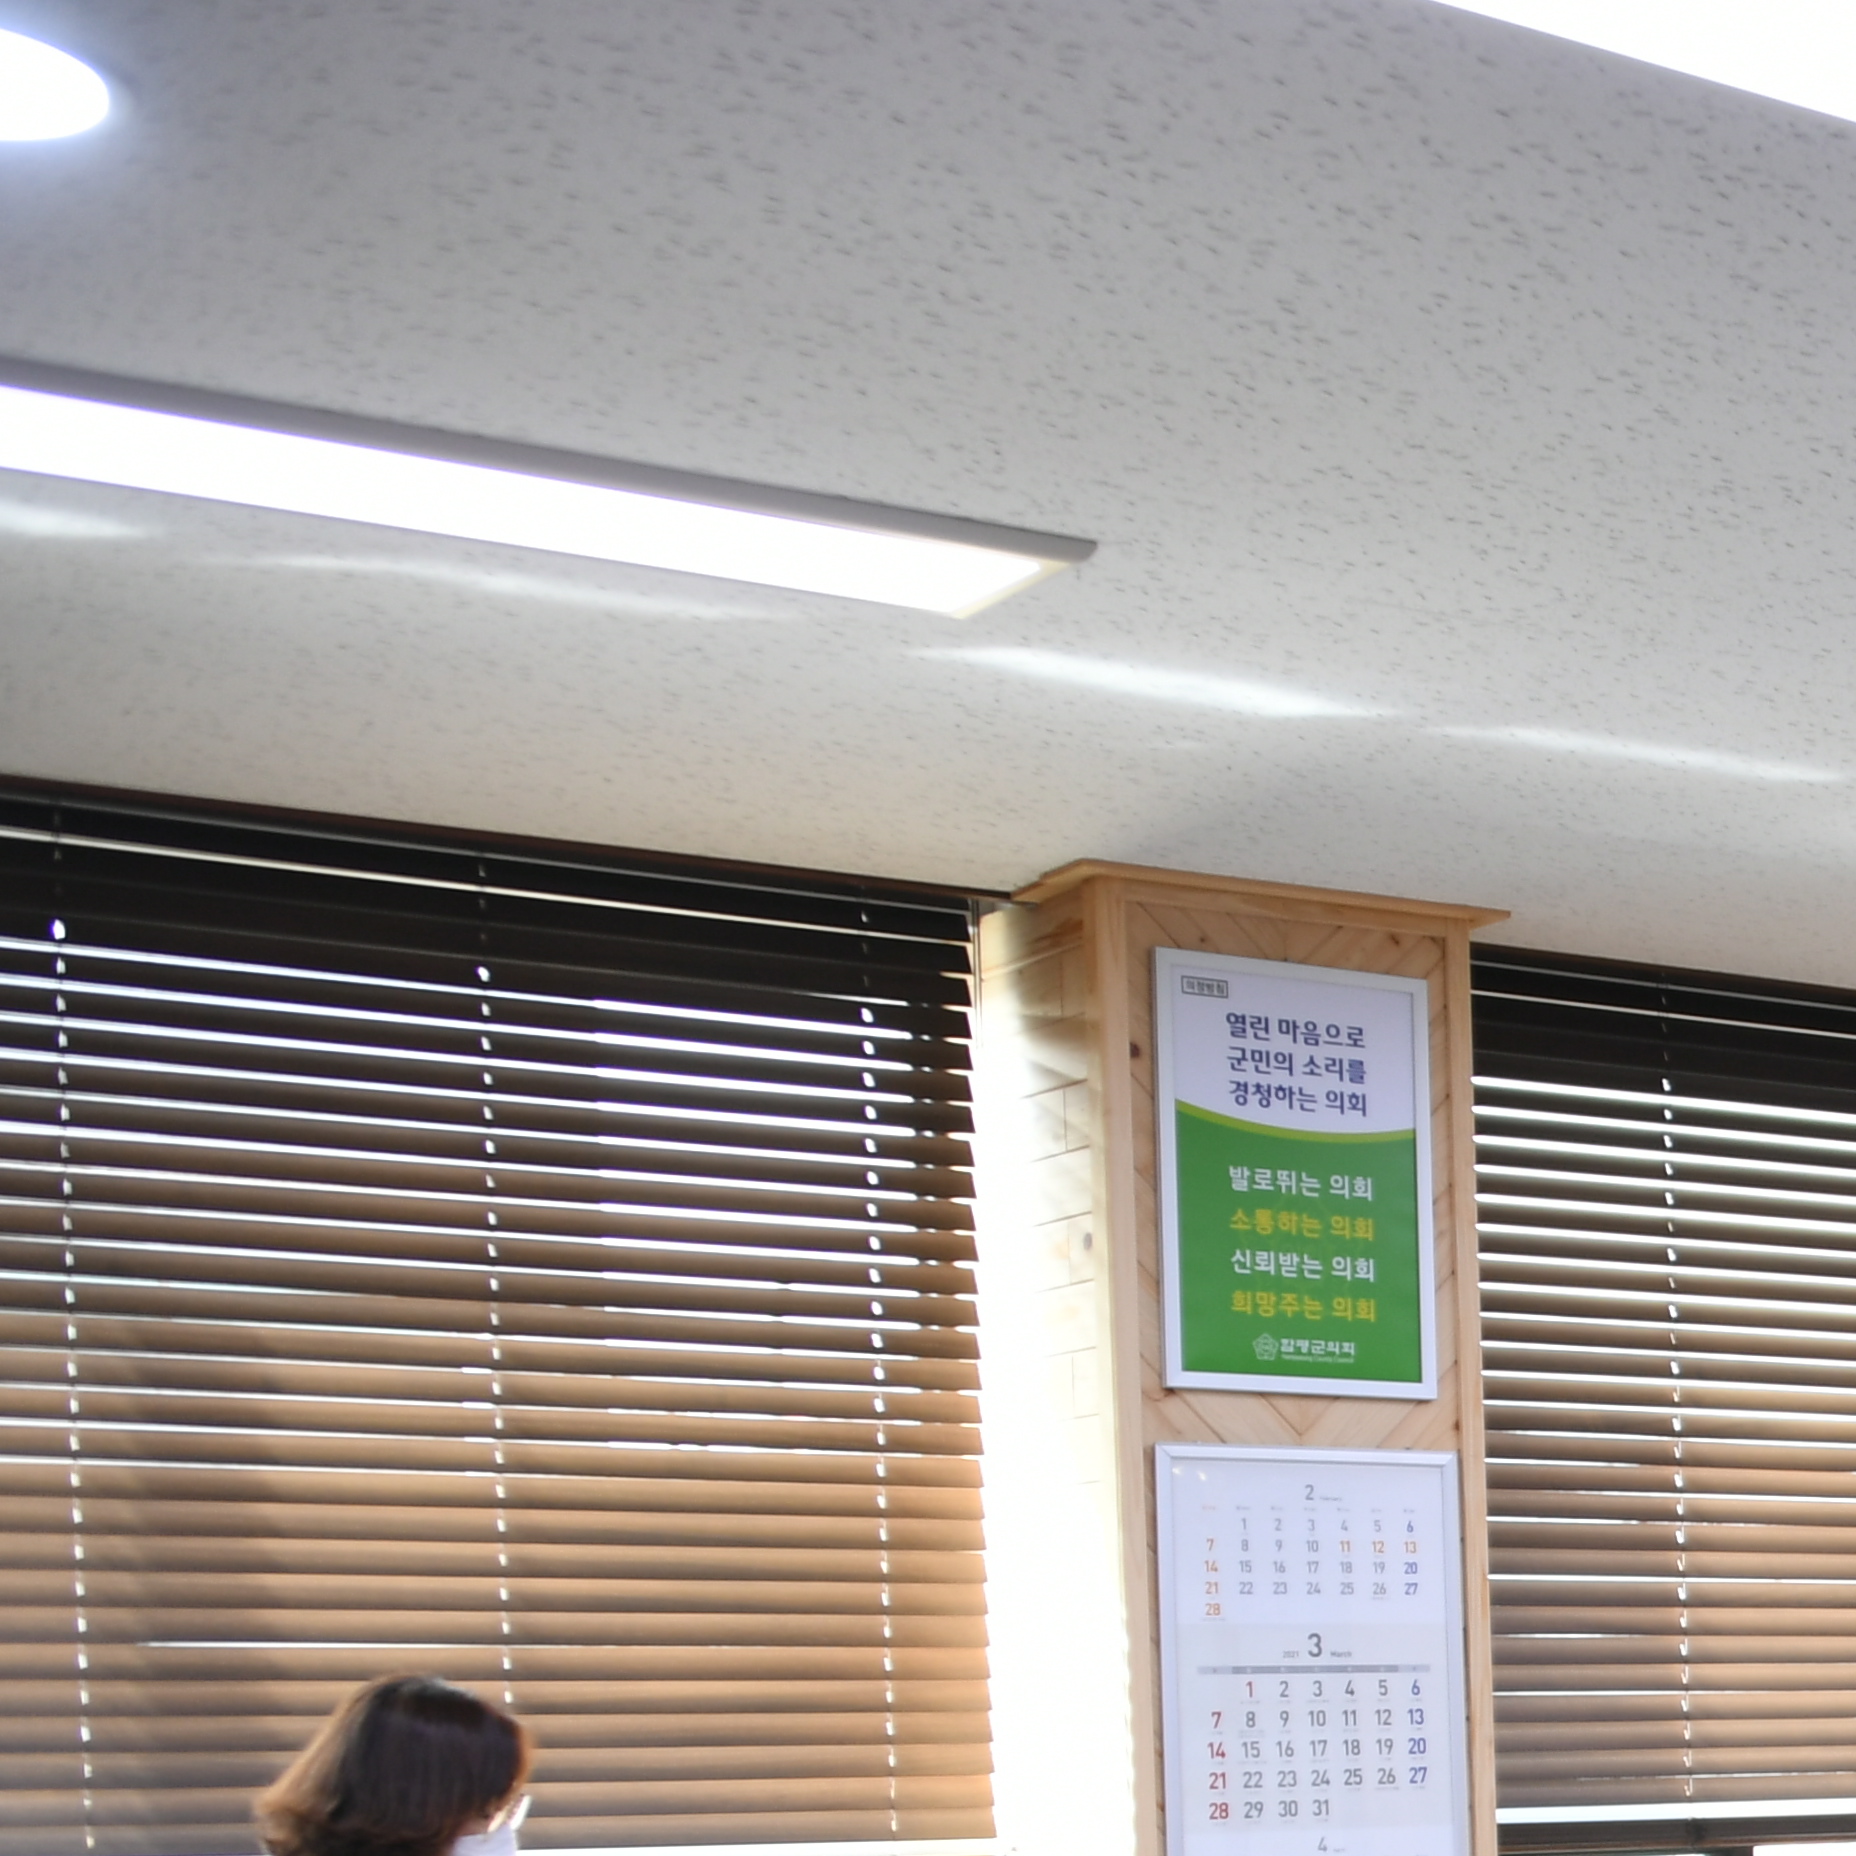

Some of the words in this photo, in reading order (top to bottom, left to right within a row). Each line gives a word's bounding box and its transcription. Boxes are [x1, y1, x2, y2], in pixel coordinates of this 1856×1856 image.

[1226, 1012, 1270, 1041] 열린
[1278, 1018, 1366, 1049] 마음으로
[1227, 1046, 1294, 1077] 군민의
[1302, 1054, 1366, 1084] 소리를
[1229, 1079, 1318, 1113] 경청하는
[1325, 1090, 1366, 1117] 의회
[1229, 1165, 1321, 1197] 발로뛰는
[1330, 1175, 1372, 1201] 의회
[1230, 1208, 1322, 1237] 소통하는
[1330, 1215, 1373, 1241] 의회
[1231, 1249, 1323, 1279] 신뢰받는
[1331, 1256, 1374, 1282] 의회
[1231, 1290, 1323, 1320] 희망주는
[1332, 1297, 1375, 1322] 의회
[1305, 1484, 1314, 1500] 2
[1242, 1518, 1246, 1530] 1
[1275, 1518, 1281, 1531] 2
[1308, 1519, 1315, 1531] 3
[1341, 1520, 1348, 1531] 4
[1374, 1520, 1381, 1532] 5
[1407, 1521, 1413, 1533] 6
[1207, 1538, 1214, 1551] 7
[1241, 1539, 1249, 1552] 8
[1275, 1540, 1282, 1552] 9
[1306, 1540, 1319, 1552] 10
[1340, 1540, 1350, 1552] 11
[1372, 1541, 1384, 1553] 12
[1405, 1541, 1417, 1554] 13
[1205, 1560, 1218, 1572] 14
[1239, 1560, 1252, 1573] 15
[1273, 1561, 1286, 1573] 16
[1307, 1561, 1319, 1573] 17
[1340, 1561, 1352, 1574] 18
[1373, 1561, 1385, 1574] 19
[1404, 1562, 1417, 1574] 20
[1206, 1582, 1218, 1594] 21
[1239, 1582, 1253, 1595] 22
[1273, 1582, 1287, 1595] 23
[1307, 1582, 1321, 1595] 24
[1340, 1582, 1354, 1595] 25
[1373, 1583, 1386, 1595] 26
[1405, 1583, 1418, 1595] 27
[1206, 1603, 1221, 1616] 28
[1308, 1633, 1322, 1657] 3
[1246, 1681, 1253, 1697] 1
[1280, 1681, 1289, 1697] 2
[1313, 1680, 1322, 1697] 3
[1345, 1680, 1355, 1696] 4
[1379, 1679, 1388, 1696] 5
[1412, 1680, 1420, 1695] 6
[1212, 1711, 1221, 1728] 7
[1246, 1711, 1255, 1728] 8
[1280, 1711, 1289, 1727] 9
[1308, 1710, 1326, 1726] 10
[1342, 1710, 1356, 1726] 11
[1375, 1709, 1392, 1725] 12
[1408, 1709, 1424, 1725] 13
[1208, 1742, 1226, 1758] 14
[1242, 1741, 1260, 1758] 15
[1276, 1741, 1294, 1757] 16
[1310, 1740, 1327, 1756] 17
[1343, 1739, 1360, 1756] 18
[1376, 1738, 1393, 1755] 19
[1408, 1738, 1426, 1754] 20
[1209, 1772, 1226, 1789] 21
[1243, 1771, 1263, 1788] 22
[1278, 1770, 1297, 1787] 23
[1311, 1770, 1330, 1786] 24
[1344, 1768, 1362, 1785] 25
[1378, 1768, 1396, 1784] 26
[1410, 1767, 1427, 1784] 27
[1210, 1802, 1229, 1819] 28
[1244, 1801, 1263, 1819] 29
[1279, 1800, 1298, 1817] 30
[1313, 1799, 1329, 1816] 31
[1318, 1837, 1327, 1852] 4
